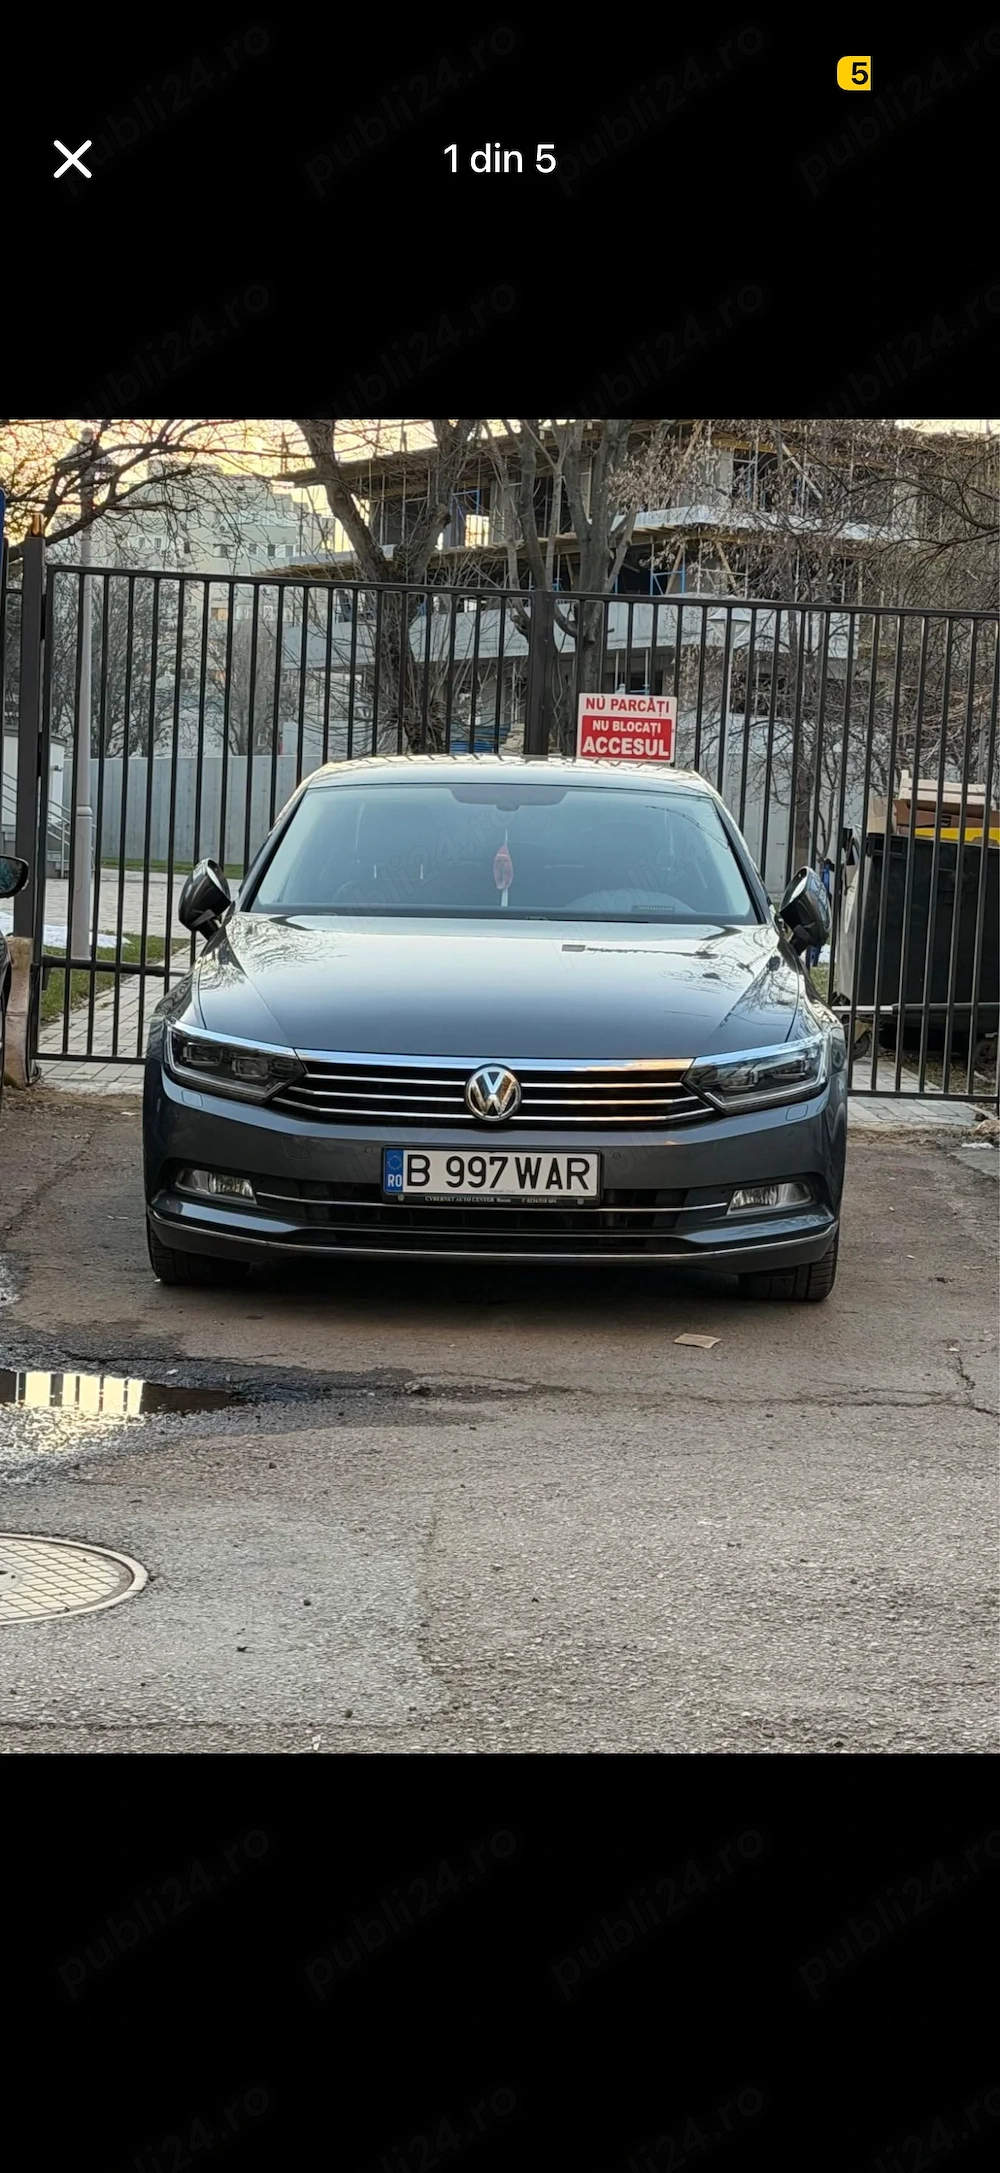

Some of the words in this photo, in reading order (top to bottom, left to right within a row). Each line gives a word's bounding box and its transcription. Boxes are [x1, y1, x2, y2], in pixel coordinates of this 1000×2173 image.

[586, 697, 606, 711] NU
[592, 720, 609, 732] NU
[612, 720, 661, 737] BLOCAȚI
[582, 736, 669, 757] ACCESUL
[467, 1067, 524, 1121] VW
[387, 1173, 402, 1187] RO
[406, 1154, 431, 1187] B
[445, 1156, 509, 1189] 997
[514, 1156, 591, 1190] WAR
